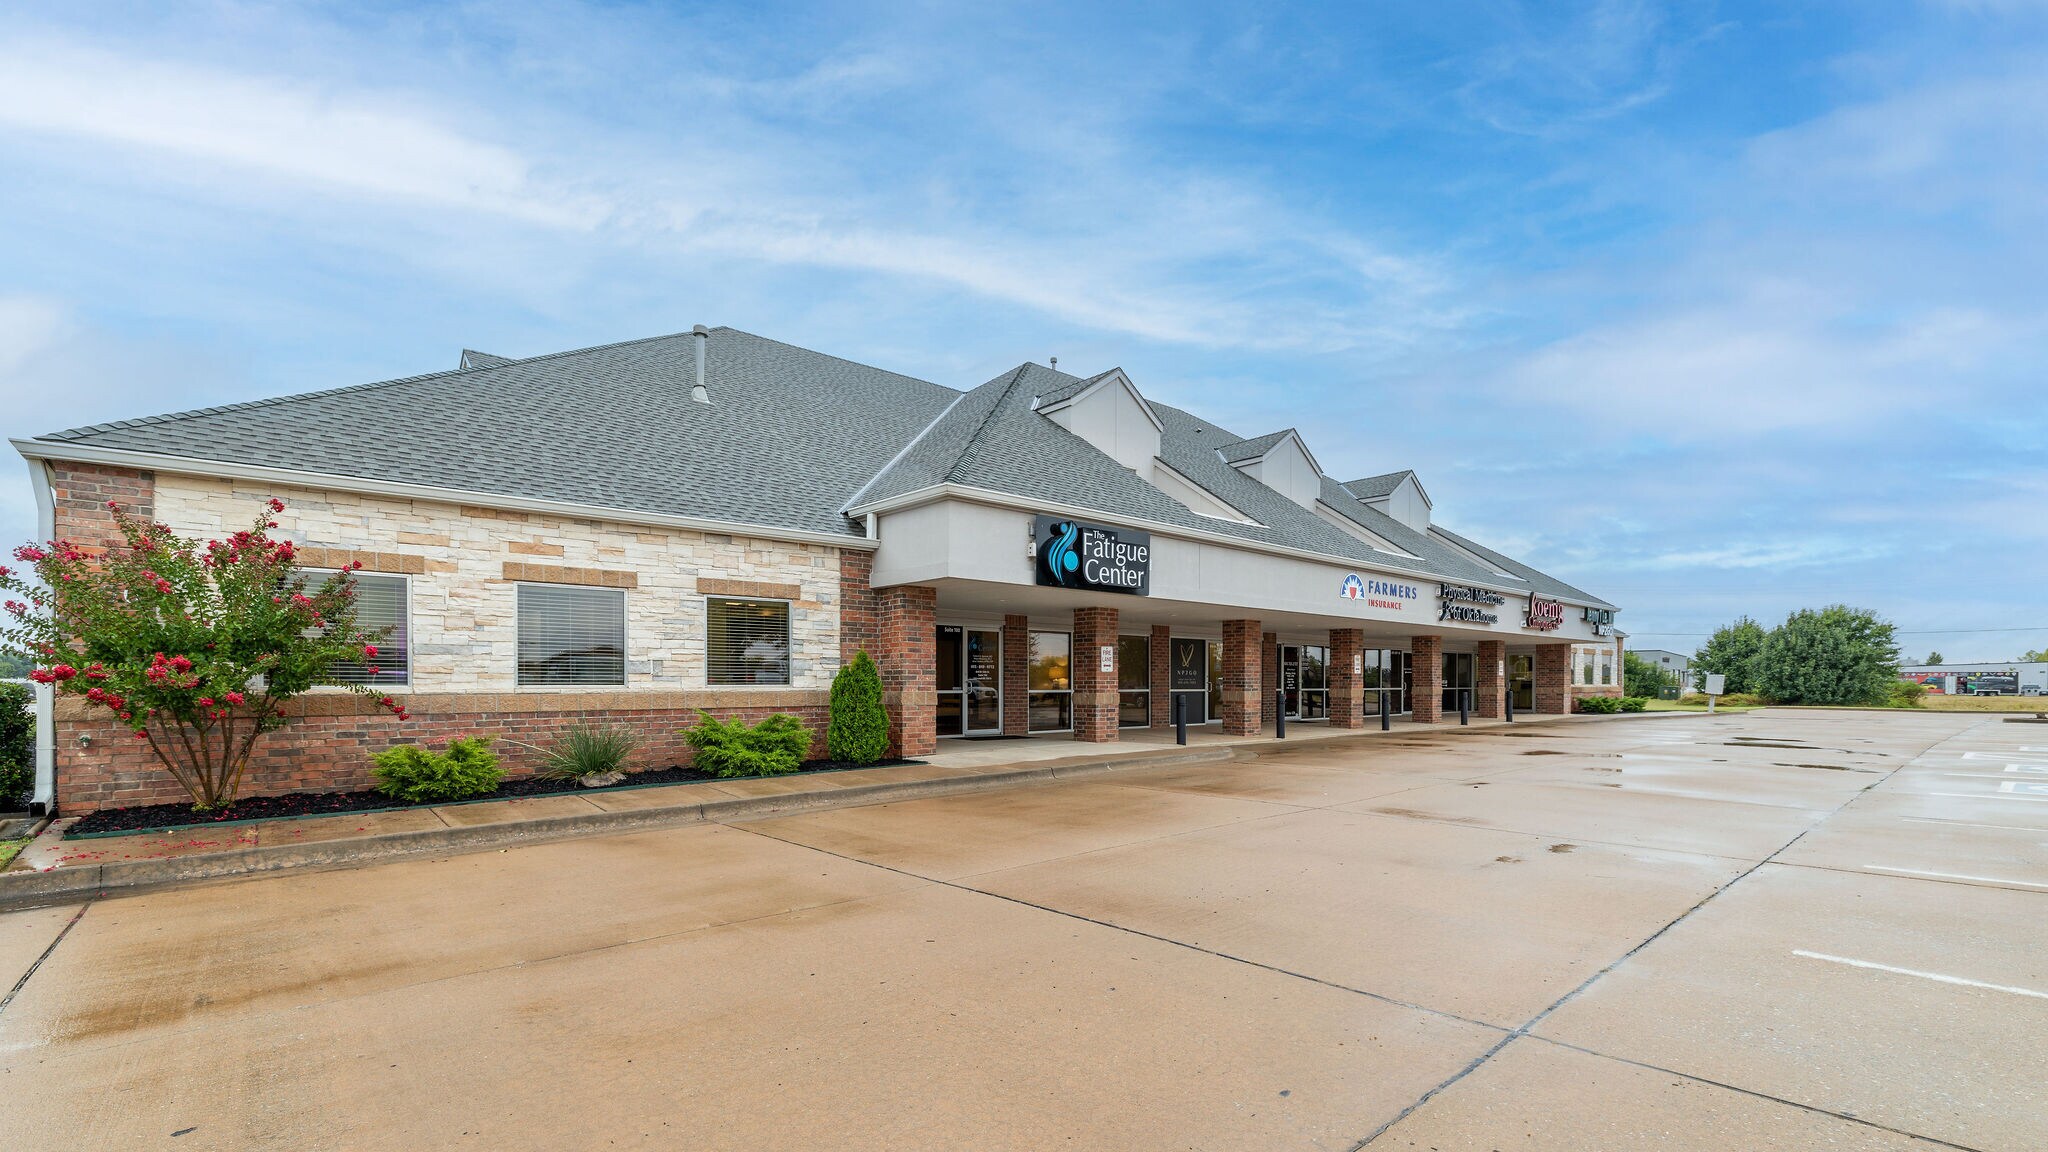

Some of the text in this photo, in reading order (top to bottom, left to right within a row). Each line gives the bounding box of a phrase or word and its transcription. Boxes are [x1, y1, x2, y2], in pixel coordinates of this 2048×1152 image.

[1093, 530, 1105, 540] The
[1083, 532, 1148, 567] Fatigue
[1084, 558, 1145, 587] Center
[1368, 579, 1417, 600] FARMERS
[1443, 583, 1505, 606] Physical Medicine
[1368, 599, 1402, 610] INSURANCE
[1530, 591, 1564, 624] Koenig
[1462, 608, 1498, 624] Oklahoma
